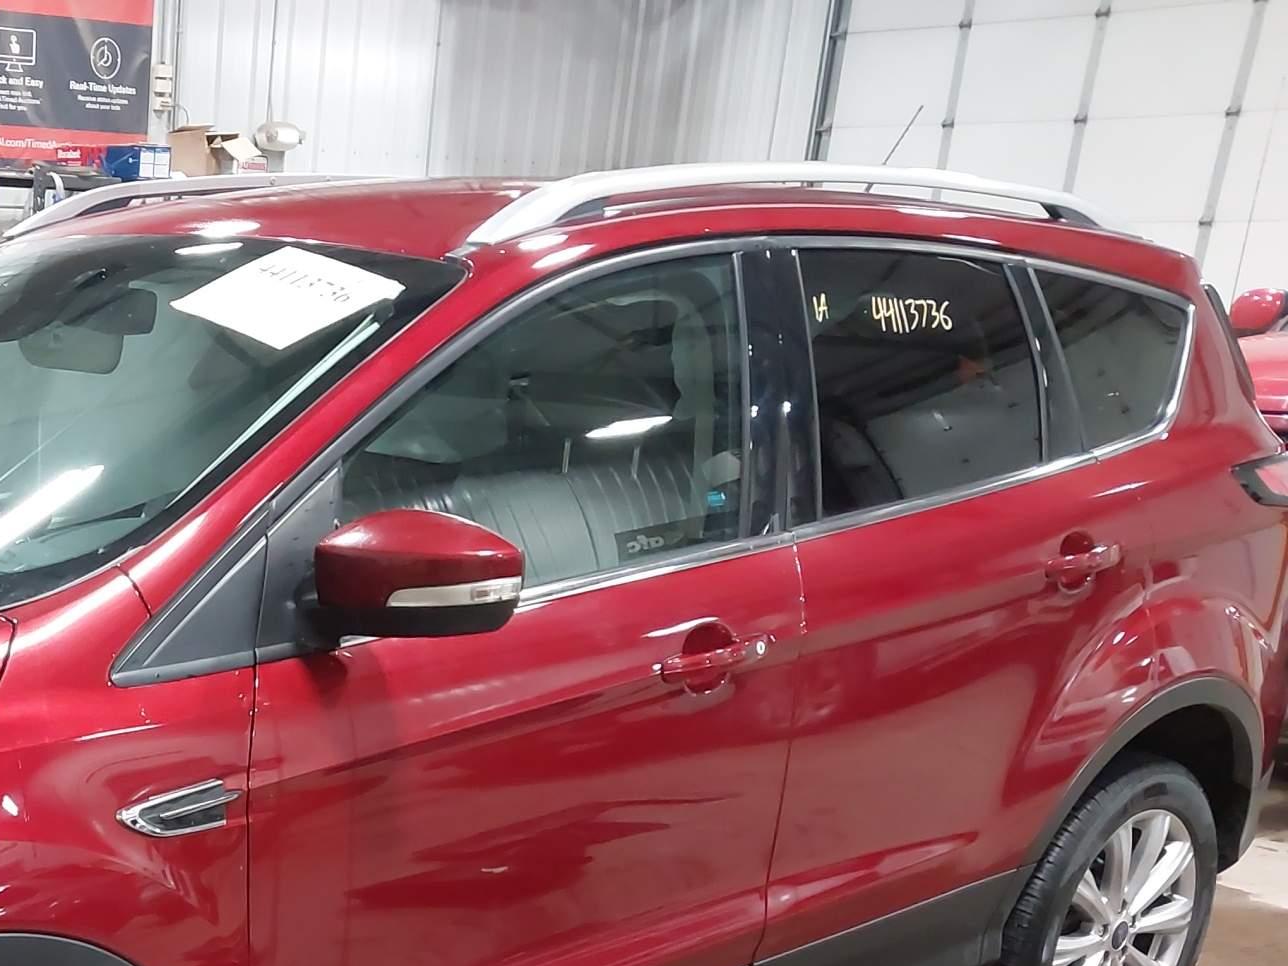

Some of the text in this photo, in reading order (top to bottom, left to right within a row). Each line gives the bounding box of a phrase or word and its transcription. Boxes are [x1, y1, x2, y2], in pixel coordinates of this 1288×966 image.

[8, 76, 24, 86] and
[24, 76, 44, 89] Easy
[69, 79, 137, 96] Real-Time Updates
[870, 296, 954, 334] 44113736
